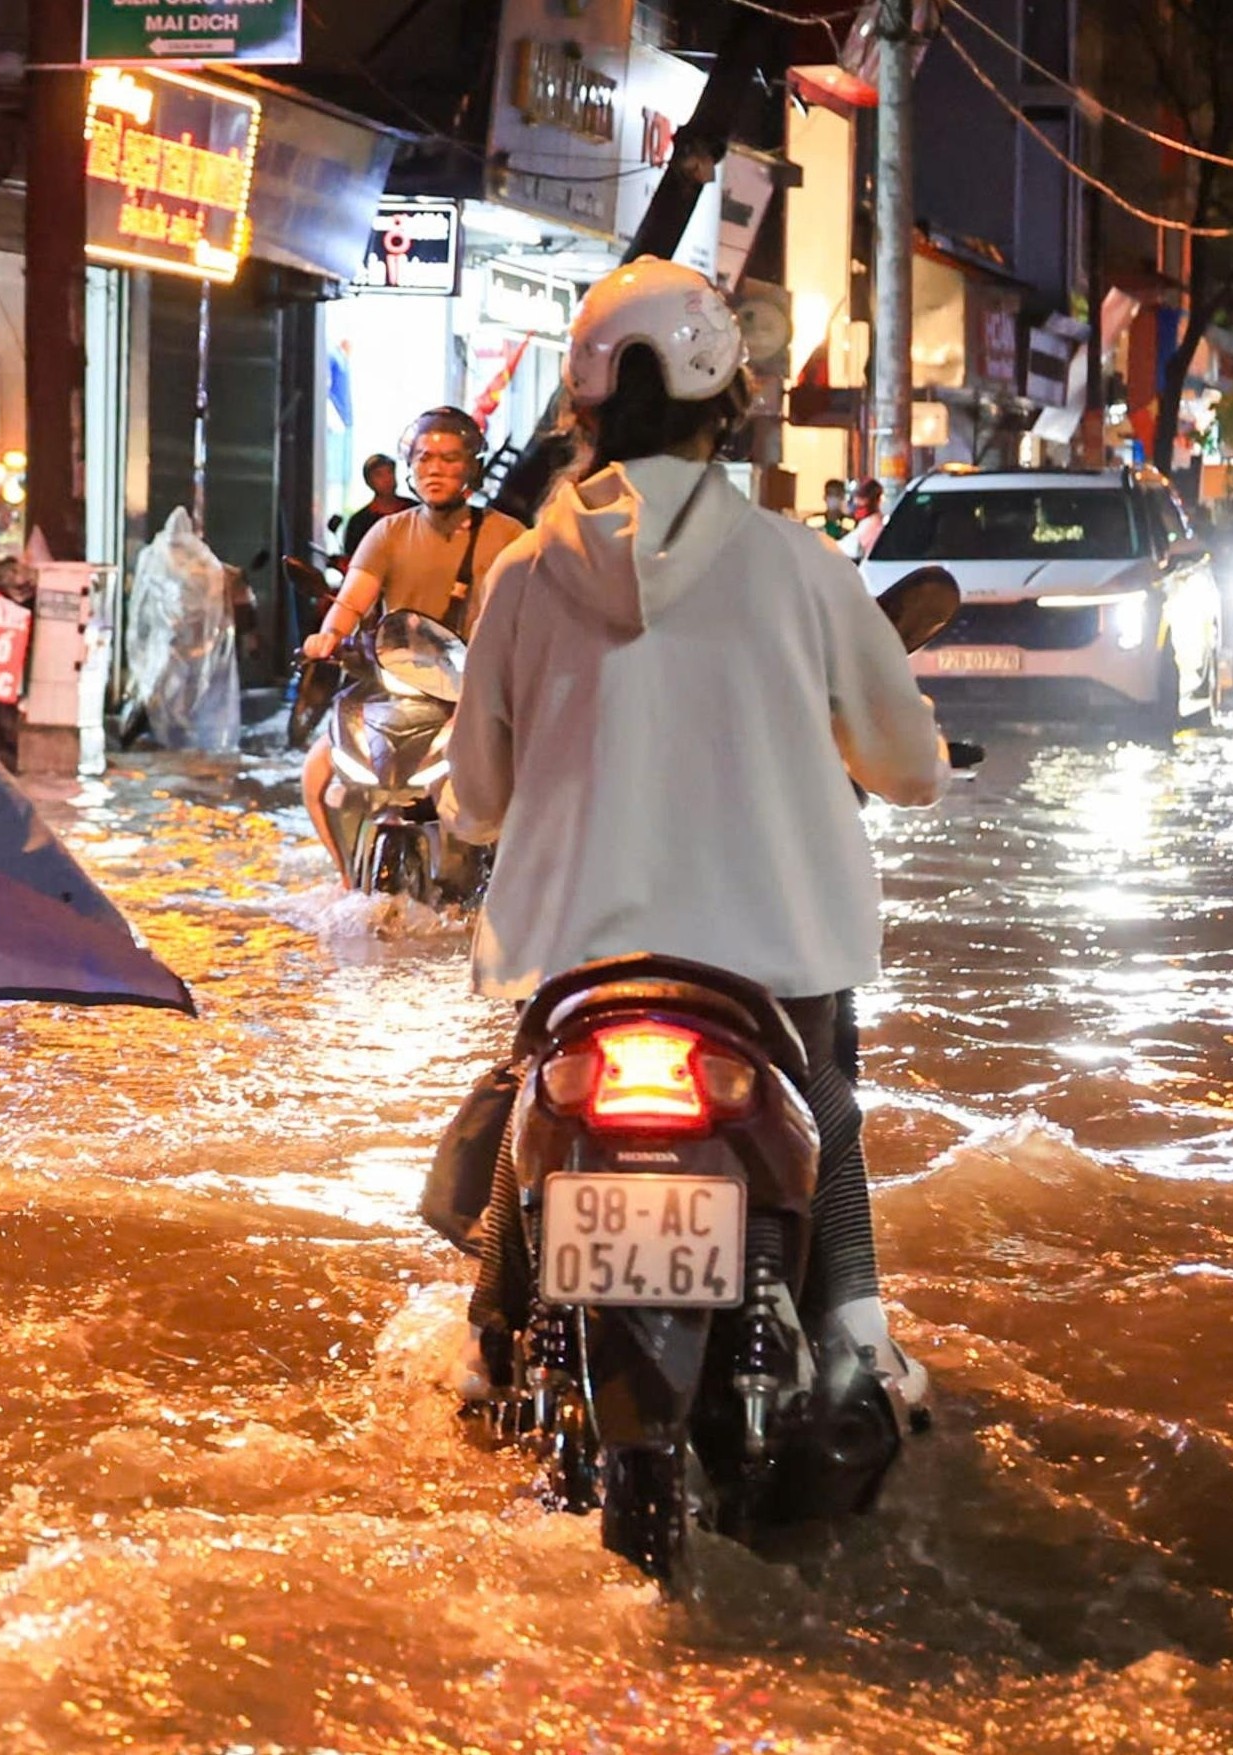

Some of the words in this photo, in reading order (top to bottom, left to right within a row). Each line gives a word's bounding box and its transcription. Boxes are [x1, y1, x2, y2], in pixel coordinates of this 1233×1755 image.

[145, 14, 184, 32] MAI
[617, 1151, 681, 1163] HONDA
[575, 1185, 712, 1238] 98-AC
[556, 1242, 728, 1297] 054.64
